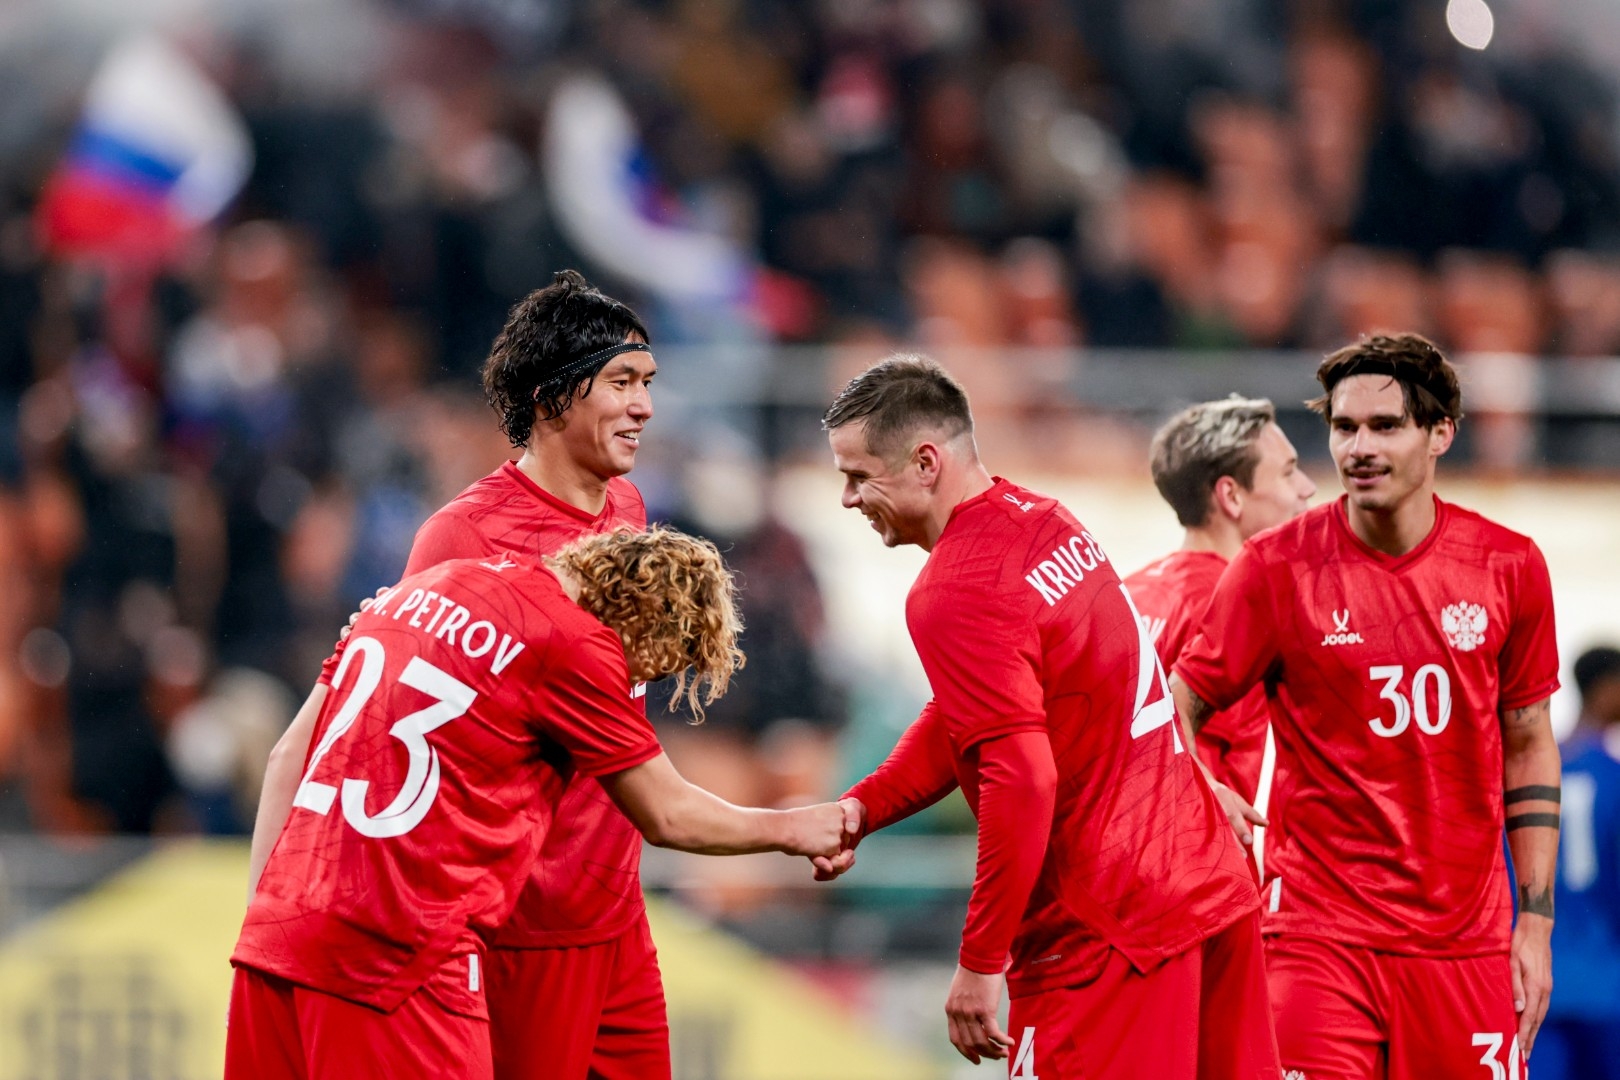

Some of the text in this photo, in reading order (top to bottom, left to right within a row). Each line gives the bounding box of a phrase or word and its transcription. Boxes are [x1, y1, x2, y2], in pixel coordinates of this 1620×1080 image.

[392, 587, 526, 676] PETROV
[1118, 582, 1185, 755] 4
[1320, 632, 1365, 647] JOGEL
[292, 635, 478, 839] 23
[1367, 663, 1453, 738] 30
